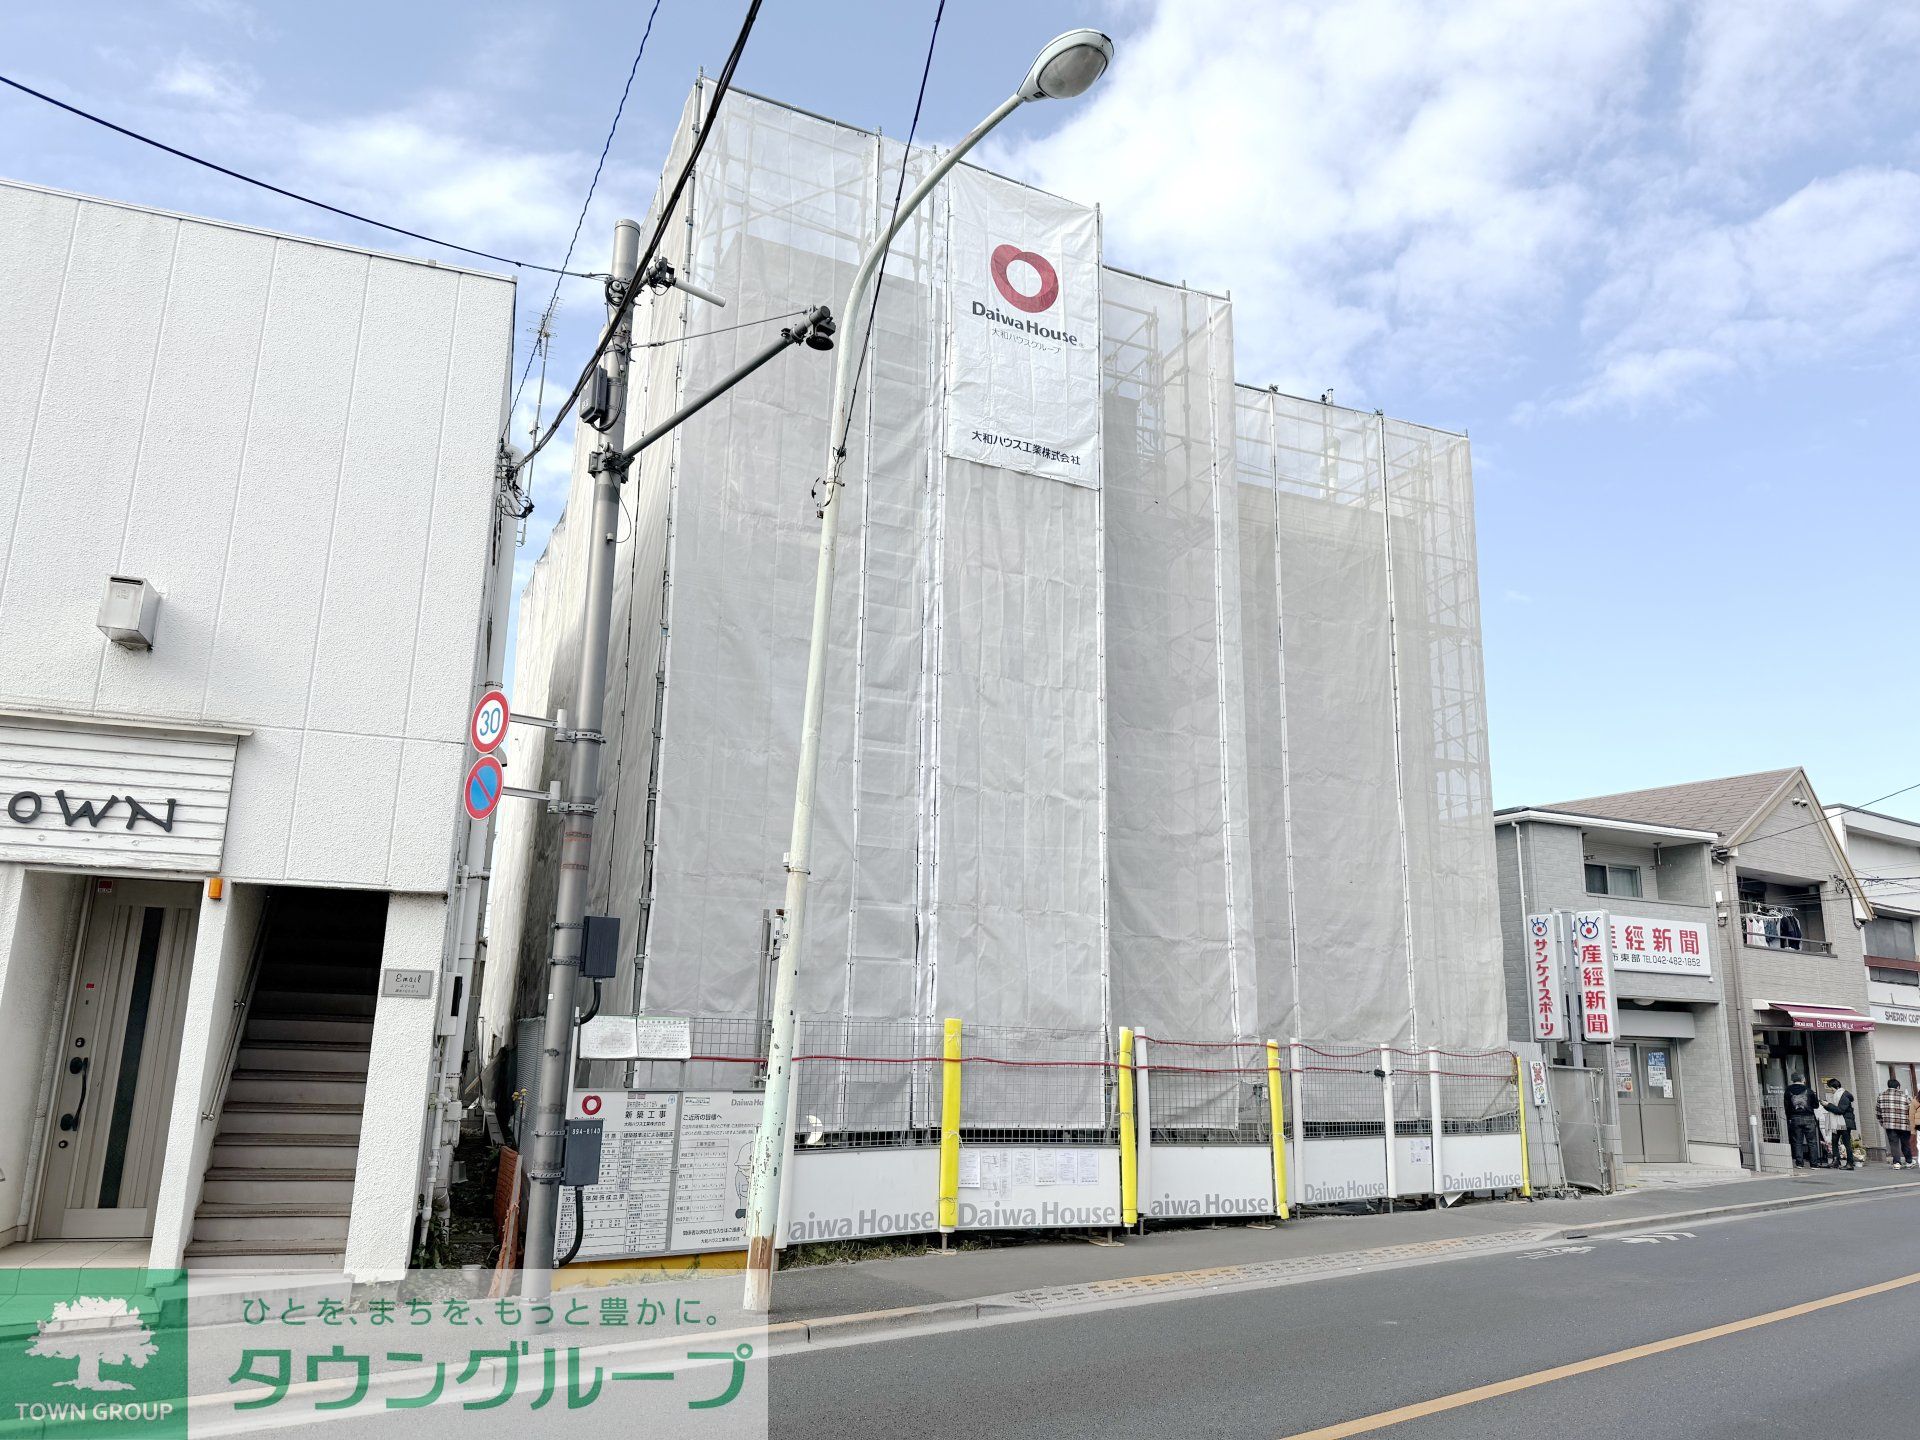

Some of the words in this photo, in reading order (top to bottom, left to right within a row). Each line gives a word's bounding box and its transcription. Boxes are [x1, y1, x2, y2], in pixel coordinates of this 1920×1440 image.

[972, 300, 1024, 331] Daiwa
[1026, 320, 1078, 346] House
[991, 327, 1062, 355] 大和ハウスグループ
[971, 431, 1081, 466] 大和ハウス工業株式会社
[479, 707, 501, 737] 30
[1533, 938, 1555, 1037] サンケイスポーツ
[1816, 1020, 1837, 1029] BUTTER
[731, 1098, 754, 1107] Daiwa
[1304, 1181, 1345, 1203] Daiwa
[1346, 1179, 1385, 1200] House
[1443, 1172, 1482, 1192] Daiwa
[1483, 1170, 1521, 1188] House
[958, 1201, 1038, 1228] Daiwa
[1041, 1201, 1117, 1226] House
[1150, 1193, 1201, 1216] aiwa
[1205, 1193, 1269, 1215] House
[787, 1212, 852, 1242] aiwa
[858, 1208, 935, 1235] House
